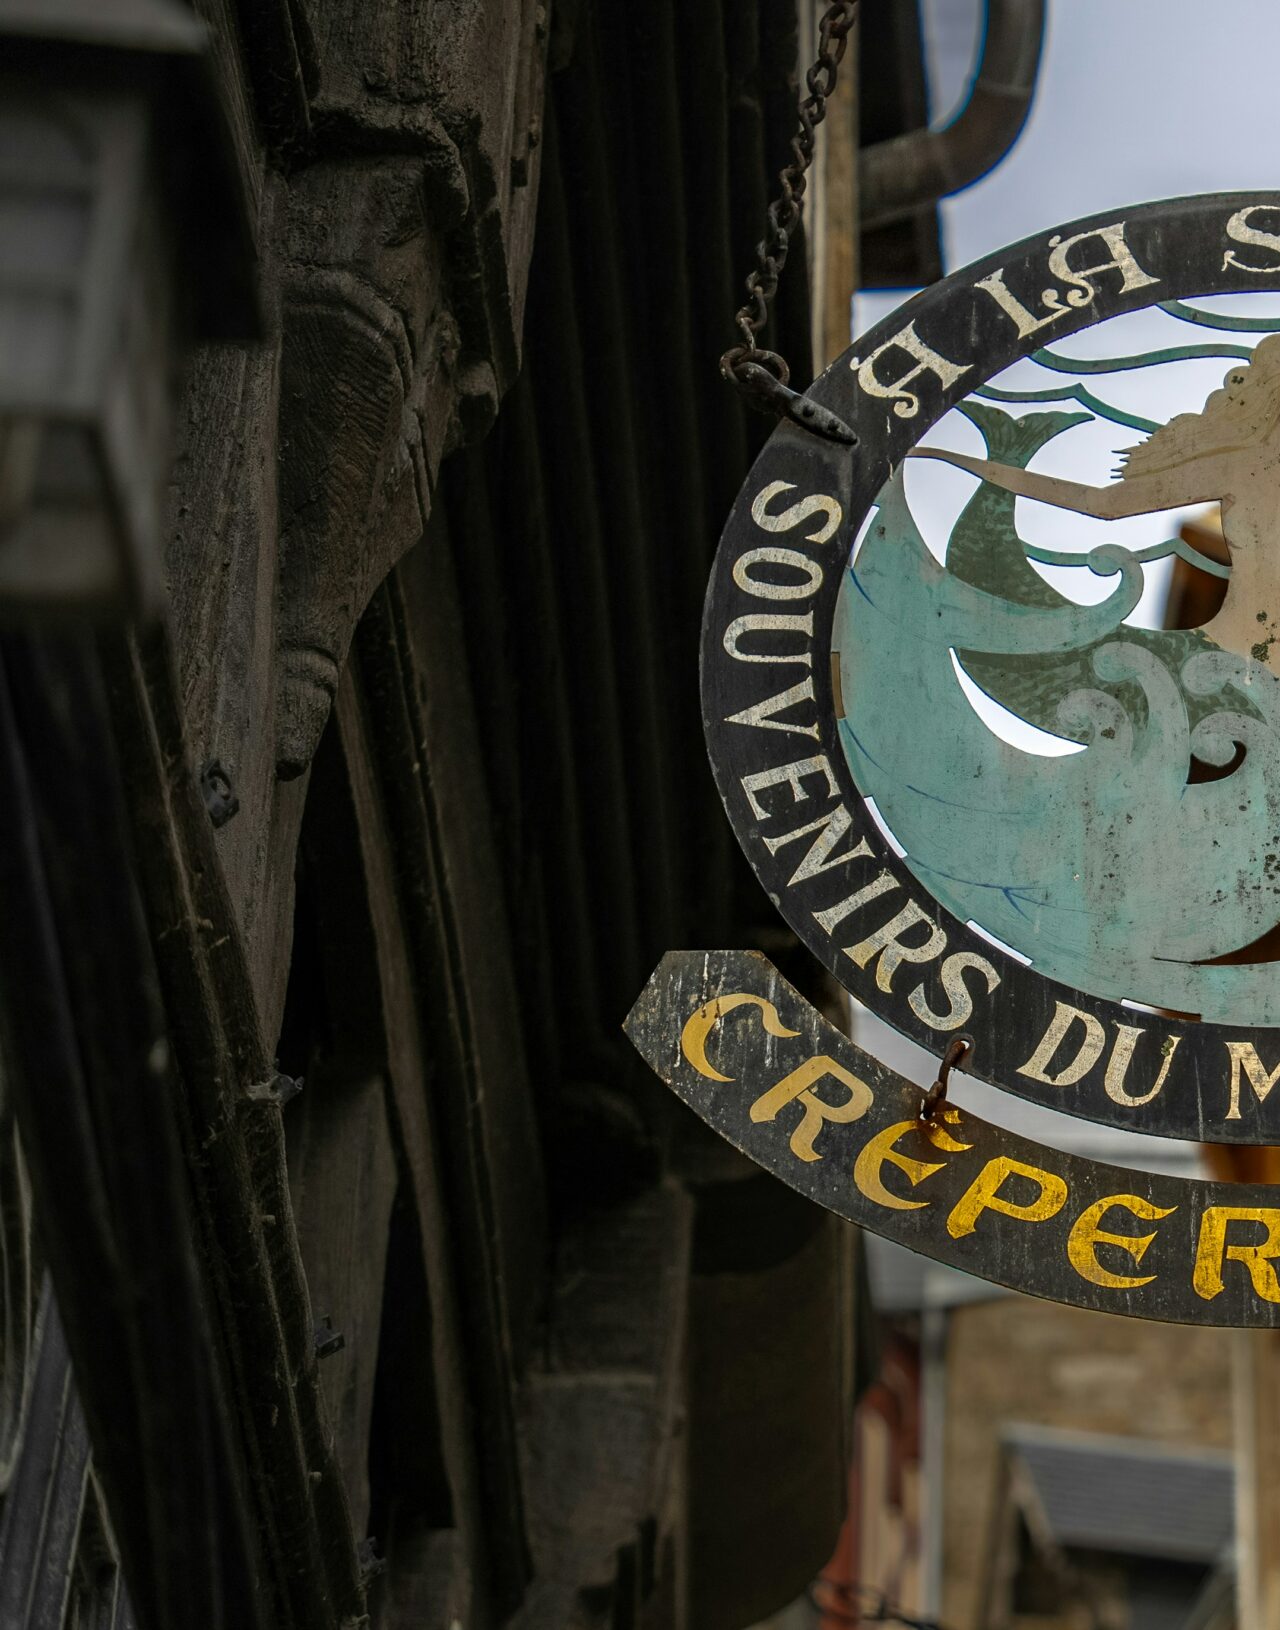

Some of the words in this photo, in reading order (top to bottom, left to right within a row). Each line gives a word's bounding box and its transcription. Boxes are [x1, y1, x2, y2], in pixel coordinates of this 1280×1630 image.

[850, 319, 974, 418] A
[974, 221, 1161, 340] LA
[723, 480, 1001, 1031] SOUVENIRS
[1016, 1000, 1181, 1107] DU
